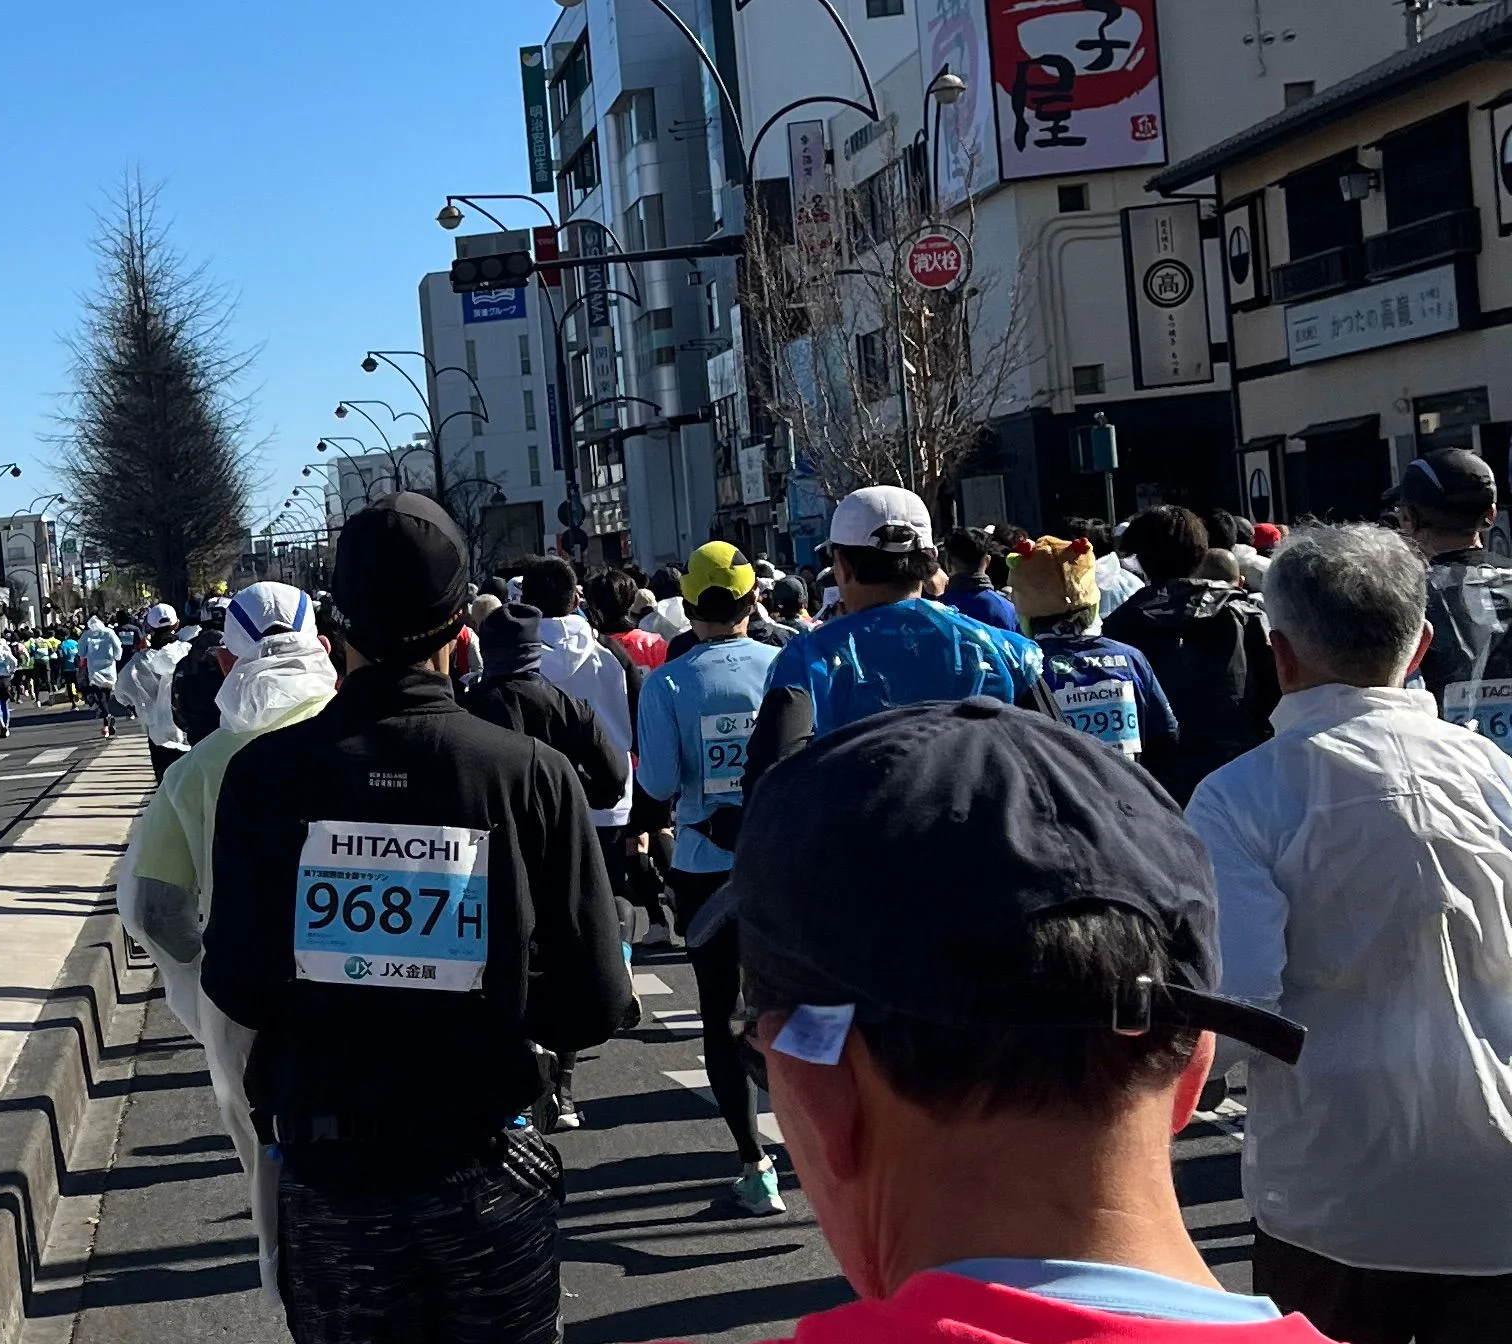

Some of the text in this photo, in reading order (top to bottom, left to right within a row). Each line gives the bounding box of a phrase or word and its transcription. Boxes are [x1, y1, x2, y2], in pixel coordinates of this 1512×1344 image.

[913, 250, 958, 273] 消火栓
[1067, 687, 1123, 704] HITACHI
[1462, 684, 1512, 699] HTAC
[331, 834, 460, 862] HITACHI
[380, 962, 437, 980] JX金属
